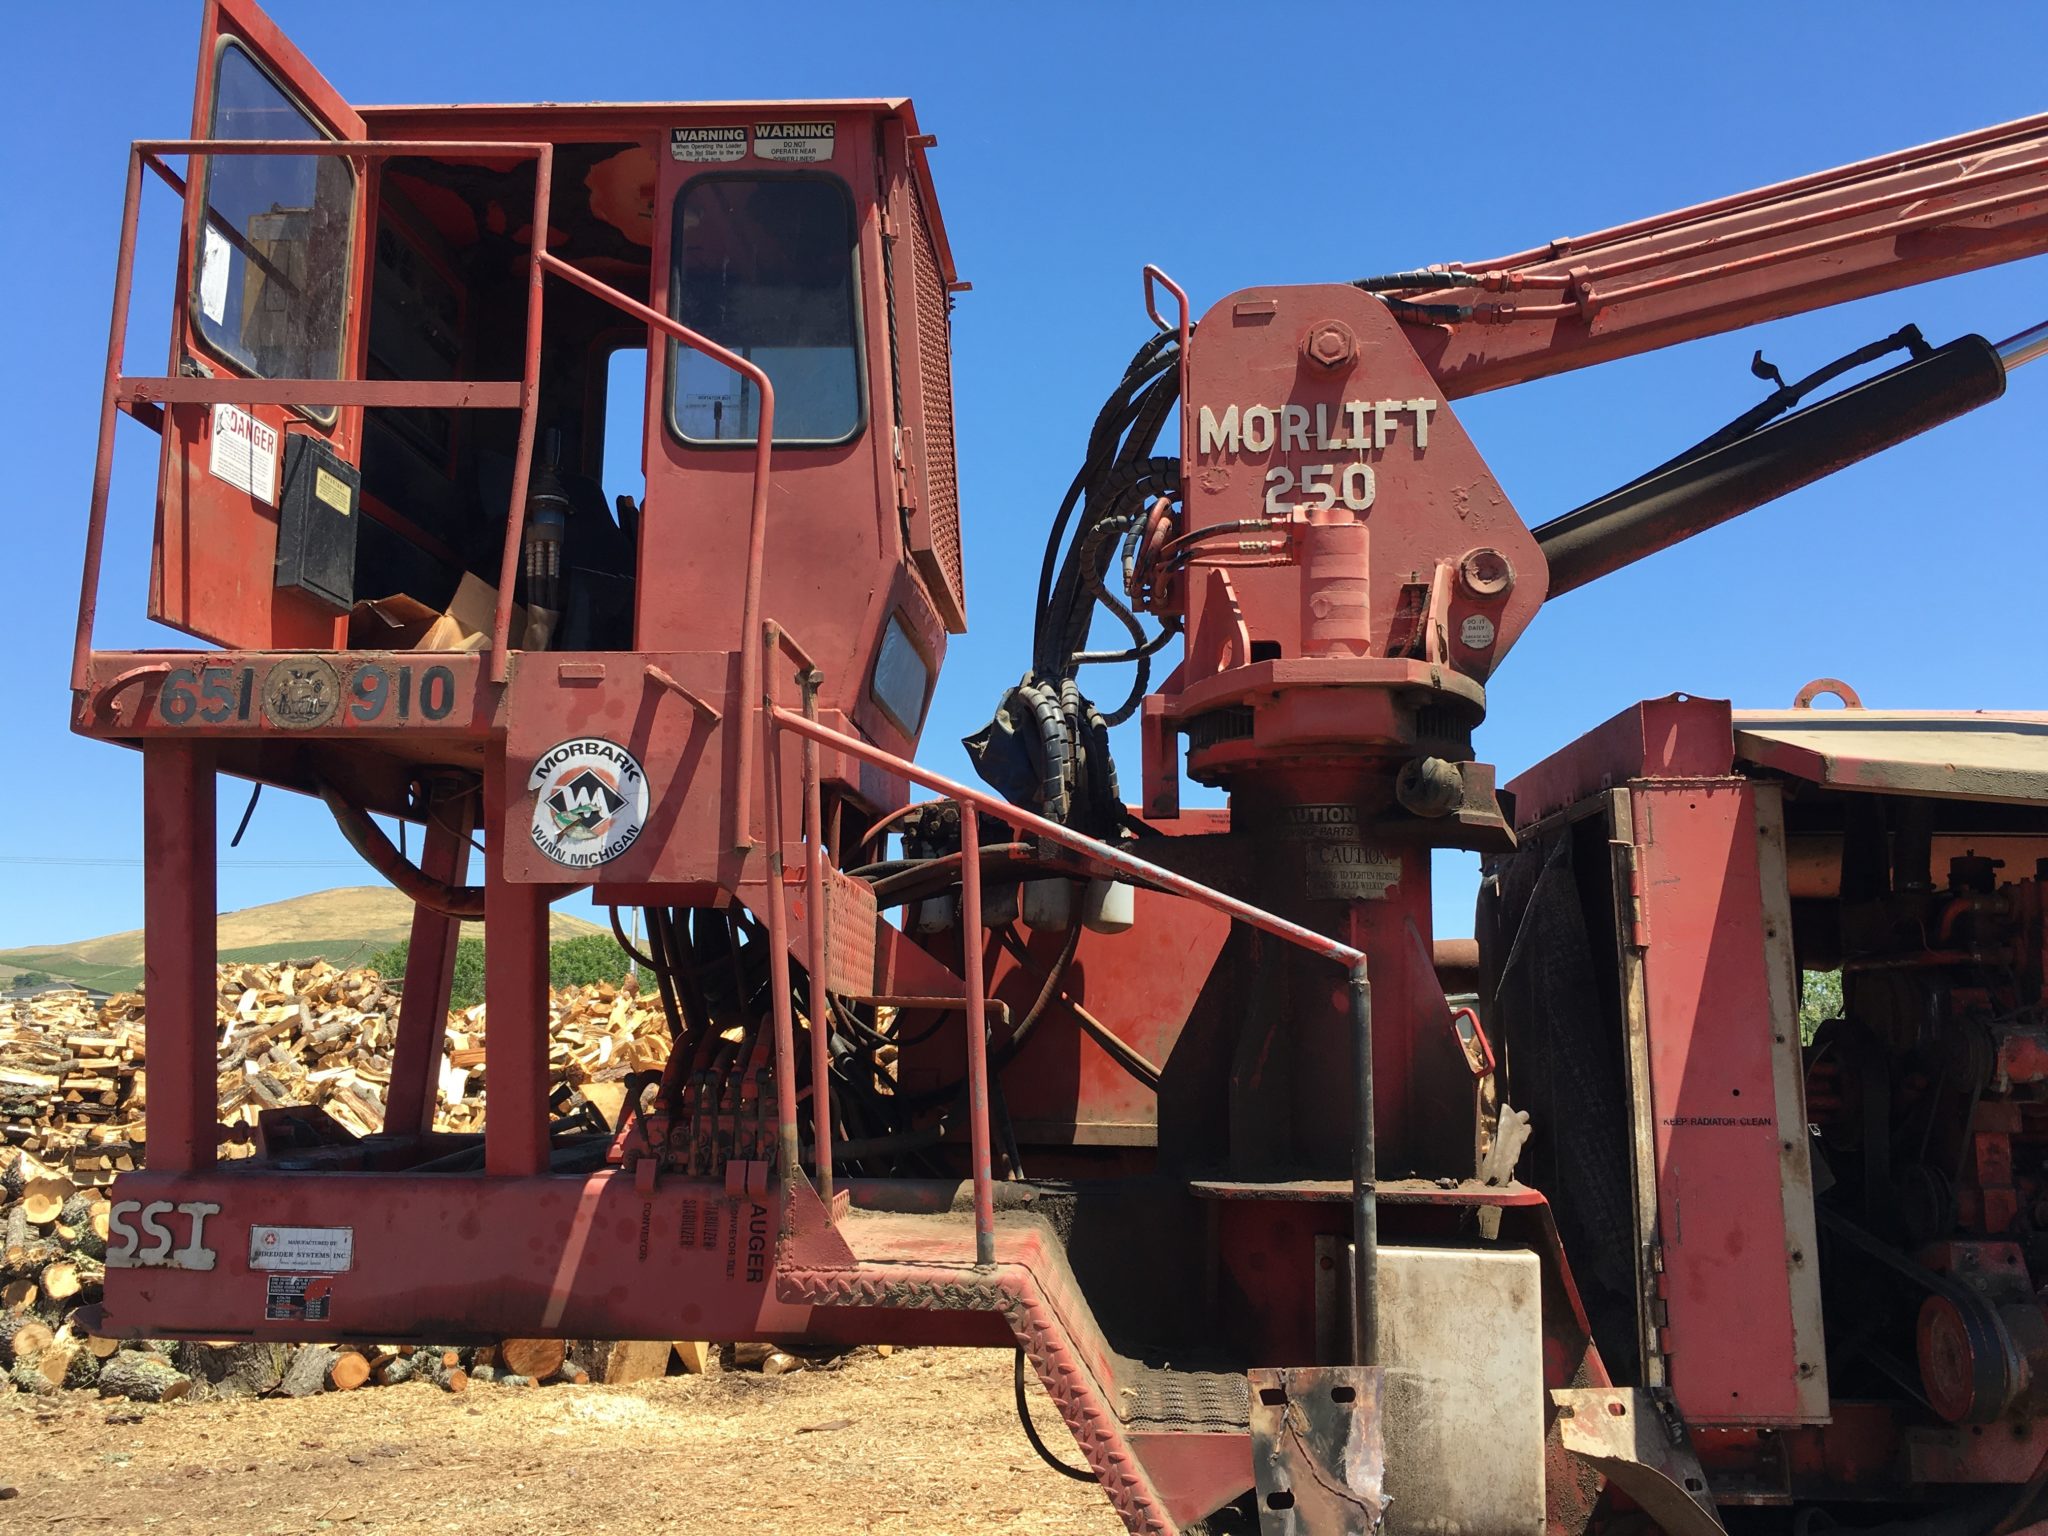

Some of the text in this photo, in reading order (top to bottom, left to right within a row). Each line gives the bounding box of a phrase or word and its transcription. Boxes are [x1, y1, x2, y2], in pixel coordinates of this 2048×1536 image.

[676, 129, 744, 141] WARNING
[755, 124, 833, 138] WARNING
[230, 411, 274, 455] DANGER
[1200, 398, 1436, 454] MORLIFT
[1266, 463, 1375, 513] 250
[160, 666, 255, 726] 651
[350, 664, 456, 721] 910
[535, 742, 640, 783] MORBARK
[532, 824, 640, 865] WINN, MICHIGAN
[1320, 826, 1353, 836] PARTS
[1663, 1117, 1771, 1126] KEEP RADIATOR CLEAN
[106, 1200, 220, 1270] SSI
[639, 1202, 652, 1263] CONVEYOR
[680, 1199, 696, 1246] STABILIZER
[727, 1205, 739, 1278] ONVEYOR TILT
[747, 1204, 768, 1283] AUGER
